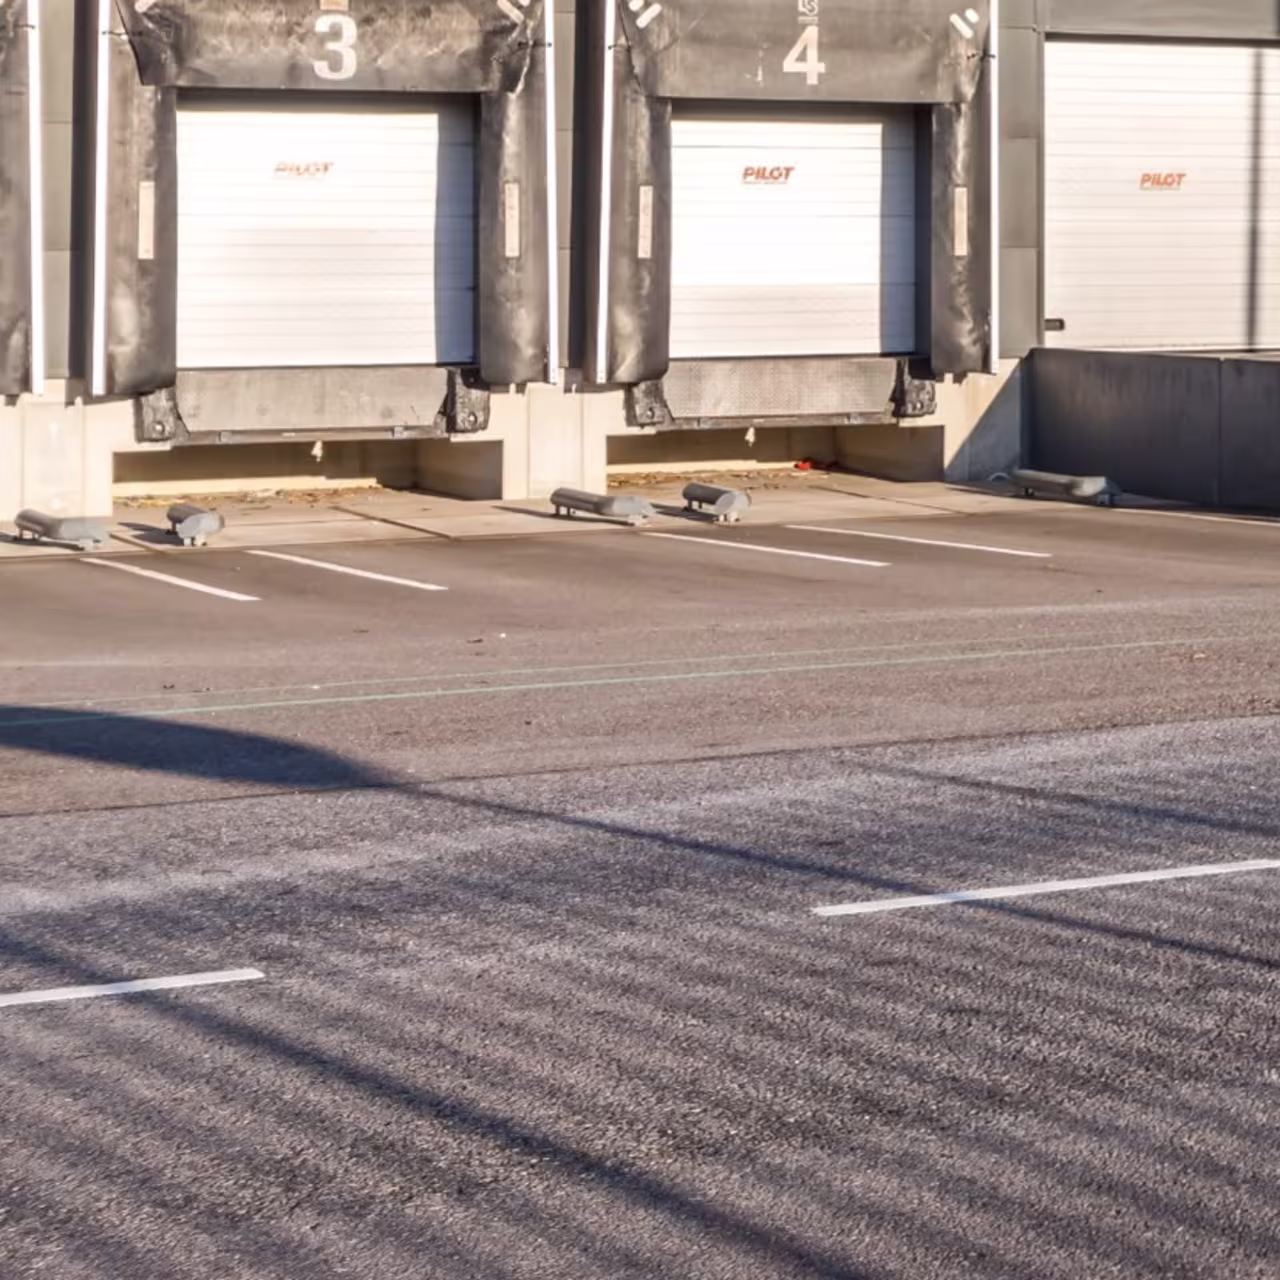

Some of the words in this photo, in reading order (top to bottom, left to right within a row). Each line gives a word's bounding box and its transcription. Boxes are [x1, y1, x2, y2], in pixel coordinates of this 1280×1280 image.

[313, 13, 358, 81] 3
[782, 24, 826, 86] 4
[742, 165, 796, 181] PILOT
[1140, 172, 1187, 187] PILOT
